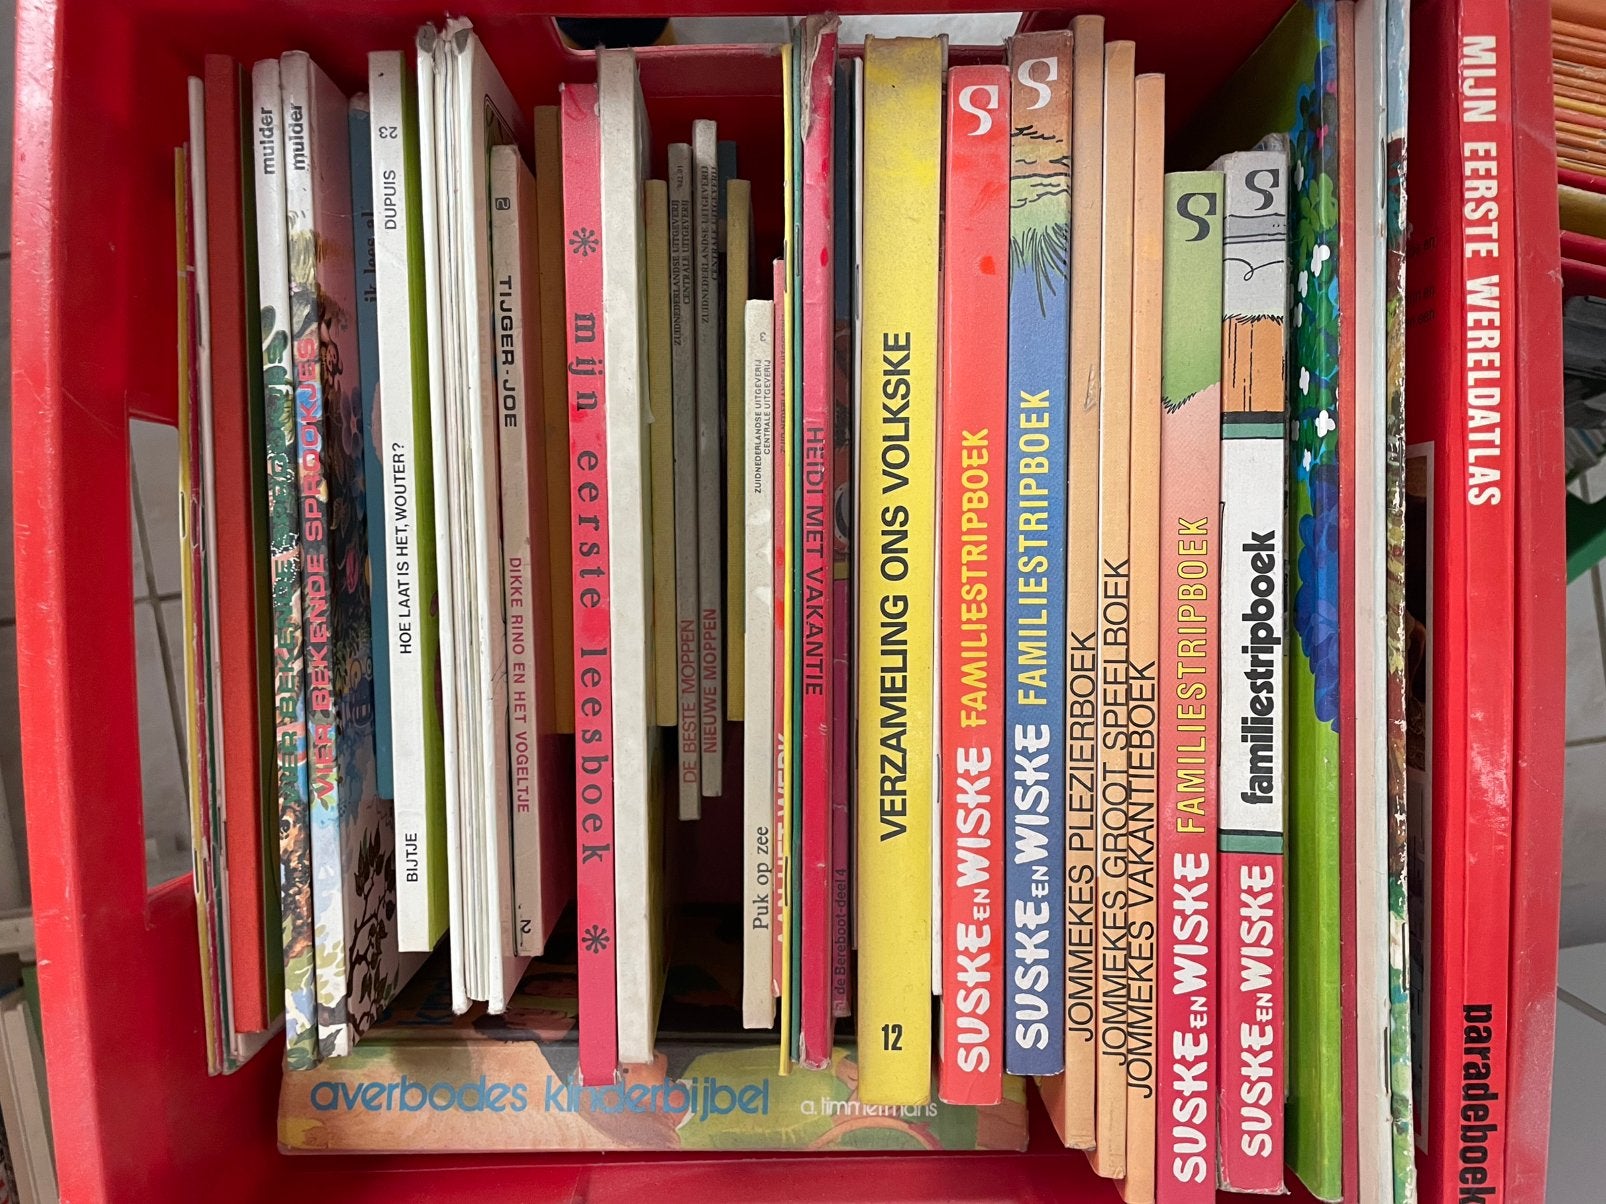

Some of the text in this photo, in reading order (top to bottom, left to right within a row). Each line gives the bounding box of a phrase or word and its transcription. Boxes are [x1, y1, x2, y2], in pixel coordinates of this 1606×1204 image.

[259, 107, 276, 175] mulder
[289, 102, 306, 172] mulder
[378, 125, 398, 139] 23
[384, 170, 398, 230] DUPUIS
[672, 200, 681, 345] ZUIDNEDERLANDSE UITGEVERIJ
[682, 200, 690, 305] CENTRALE UITGEVERIJ
[700, 165, 710, 324] ZUIDNEDERLANDSE UITGEVERIJ
[710, 227, 719, 281] CENTRALE
[1463, 35, 1502, 506] MIJN EERSTE WERELDATLAS
[759, 331, 767, 342] 3
[754, 412, 762, 494] ZUIDNEDERLANDSE
[297, 337, 335, 799] VIER BEKENDE SPROOKJES
[392, 442, 412, 654] HOE LAAT IS HET, WOUTER?
[568, 312, 611, 864] mijn eerste leesboek
[805, 427, 824, 697] HEIDI MET VAKANTIE
[880, 331, 911, 841] VERZAMELING ONS VOLKSKE
[275, 559, 297, 718] BEKENDE
[509, 557, 530, 814] DIKKE RINO EN HET VOGELTJE
[680, 619, 697, 784] DE BESTE MOPPEN
[702, 608, 718, 754] NIEUWE MOPPEN
[281, 731, 299, 806] VIER
[957, 427, 992, 1073] SUSKE EN WISKE FAMILIESTRIPBOEK
[1014, 389, 1050, 1050] SUSKE EN WISKE FAMILIESTRIPBOEK
[405, 832, 419, 883] BIJTJE
[752, 825, 773, 930] Puk op zee
[834, 867, 846, 877] 4
[1068, 631, 1096, 1042] JOMMEKES PLEZIERBOEK
[1102, 558, 1129, 1066] JOMMEKES GROOT SPEELBOEK
[1127, 661, 1156, 1098] JOMMEKES VAKANTIEBOEK
[1172, 516, 1210, 1184] SUSKE EN WISKE FAMILIESTRIPBOEK
[1240, 530, 1281, 1158] SUSKE EN WISKE familiestripboek
[519, 919, 532, 934] 2
[834, 978, 846, 996] de
[311, 1072, 769, 1121] averbodes kinderbijbel
[800, 1100, 818, 1115] a.
[881, 1023, 903, 1051] 12
